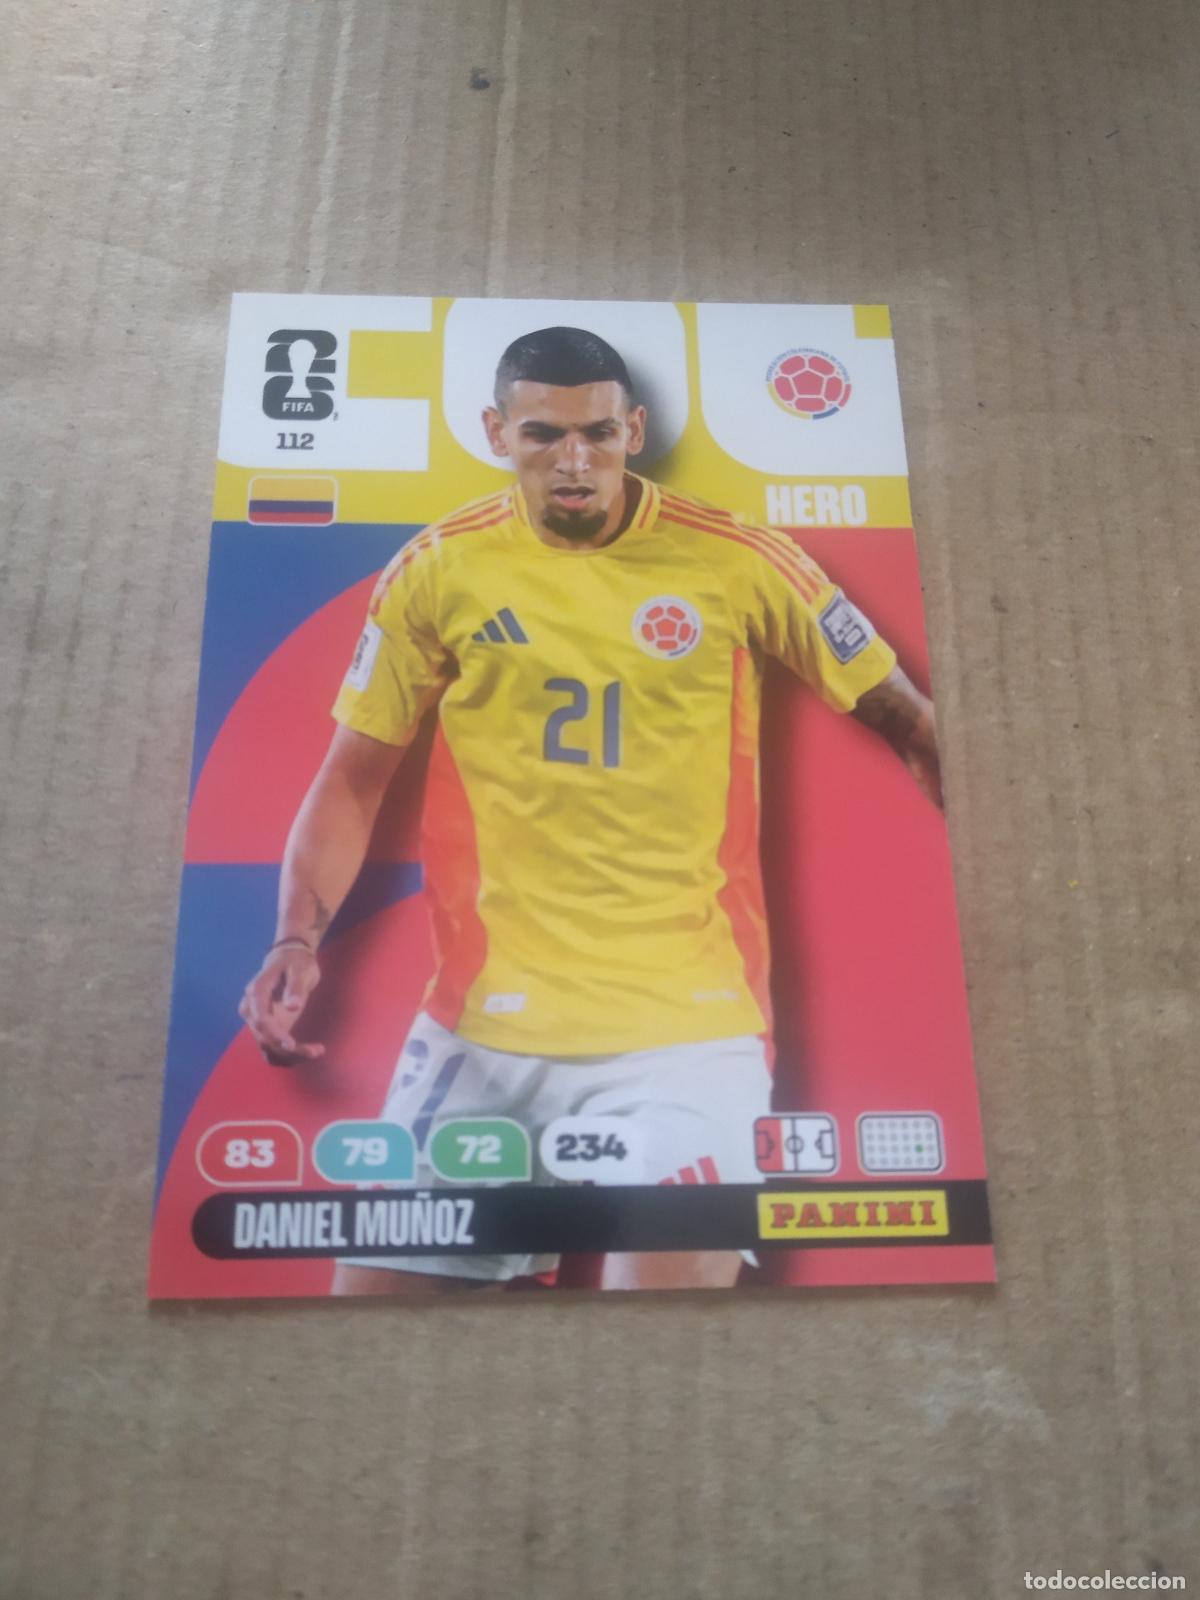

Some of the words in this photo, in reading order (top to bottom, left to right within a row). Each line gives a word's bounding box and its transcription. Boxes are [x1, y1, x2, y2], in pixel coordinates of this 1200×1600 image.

[282, 402, 314, 412] FIFA
[276, 432, 314, 450] 112
[766, 484, 868, 526] HERO
[543, 677, 621, 768] 21
[224, 1139, 275, 1168] 83
[341, 1137, 388, 1166] 79
[456, 1134, 502, 1164] 72
[555, 1133, 628, 1161] 234
[233, 1202, 348, 1249] DANIEL
[354, 1191, 475, 1247] MUÑOZ
[770, 1200, 937, 1229] PANINI
